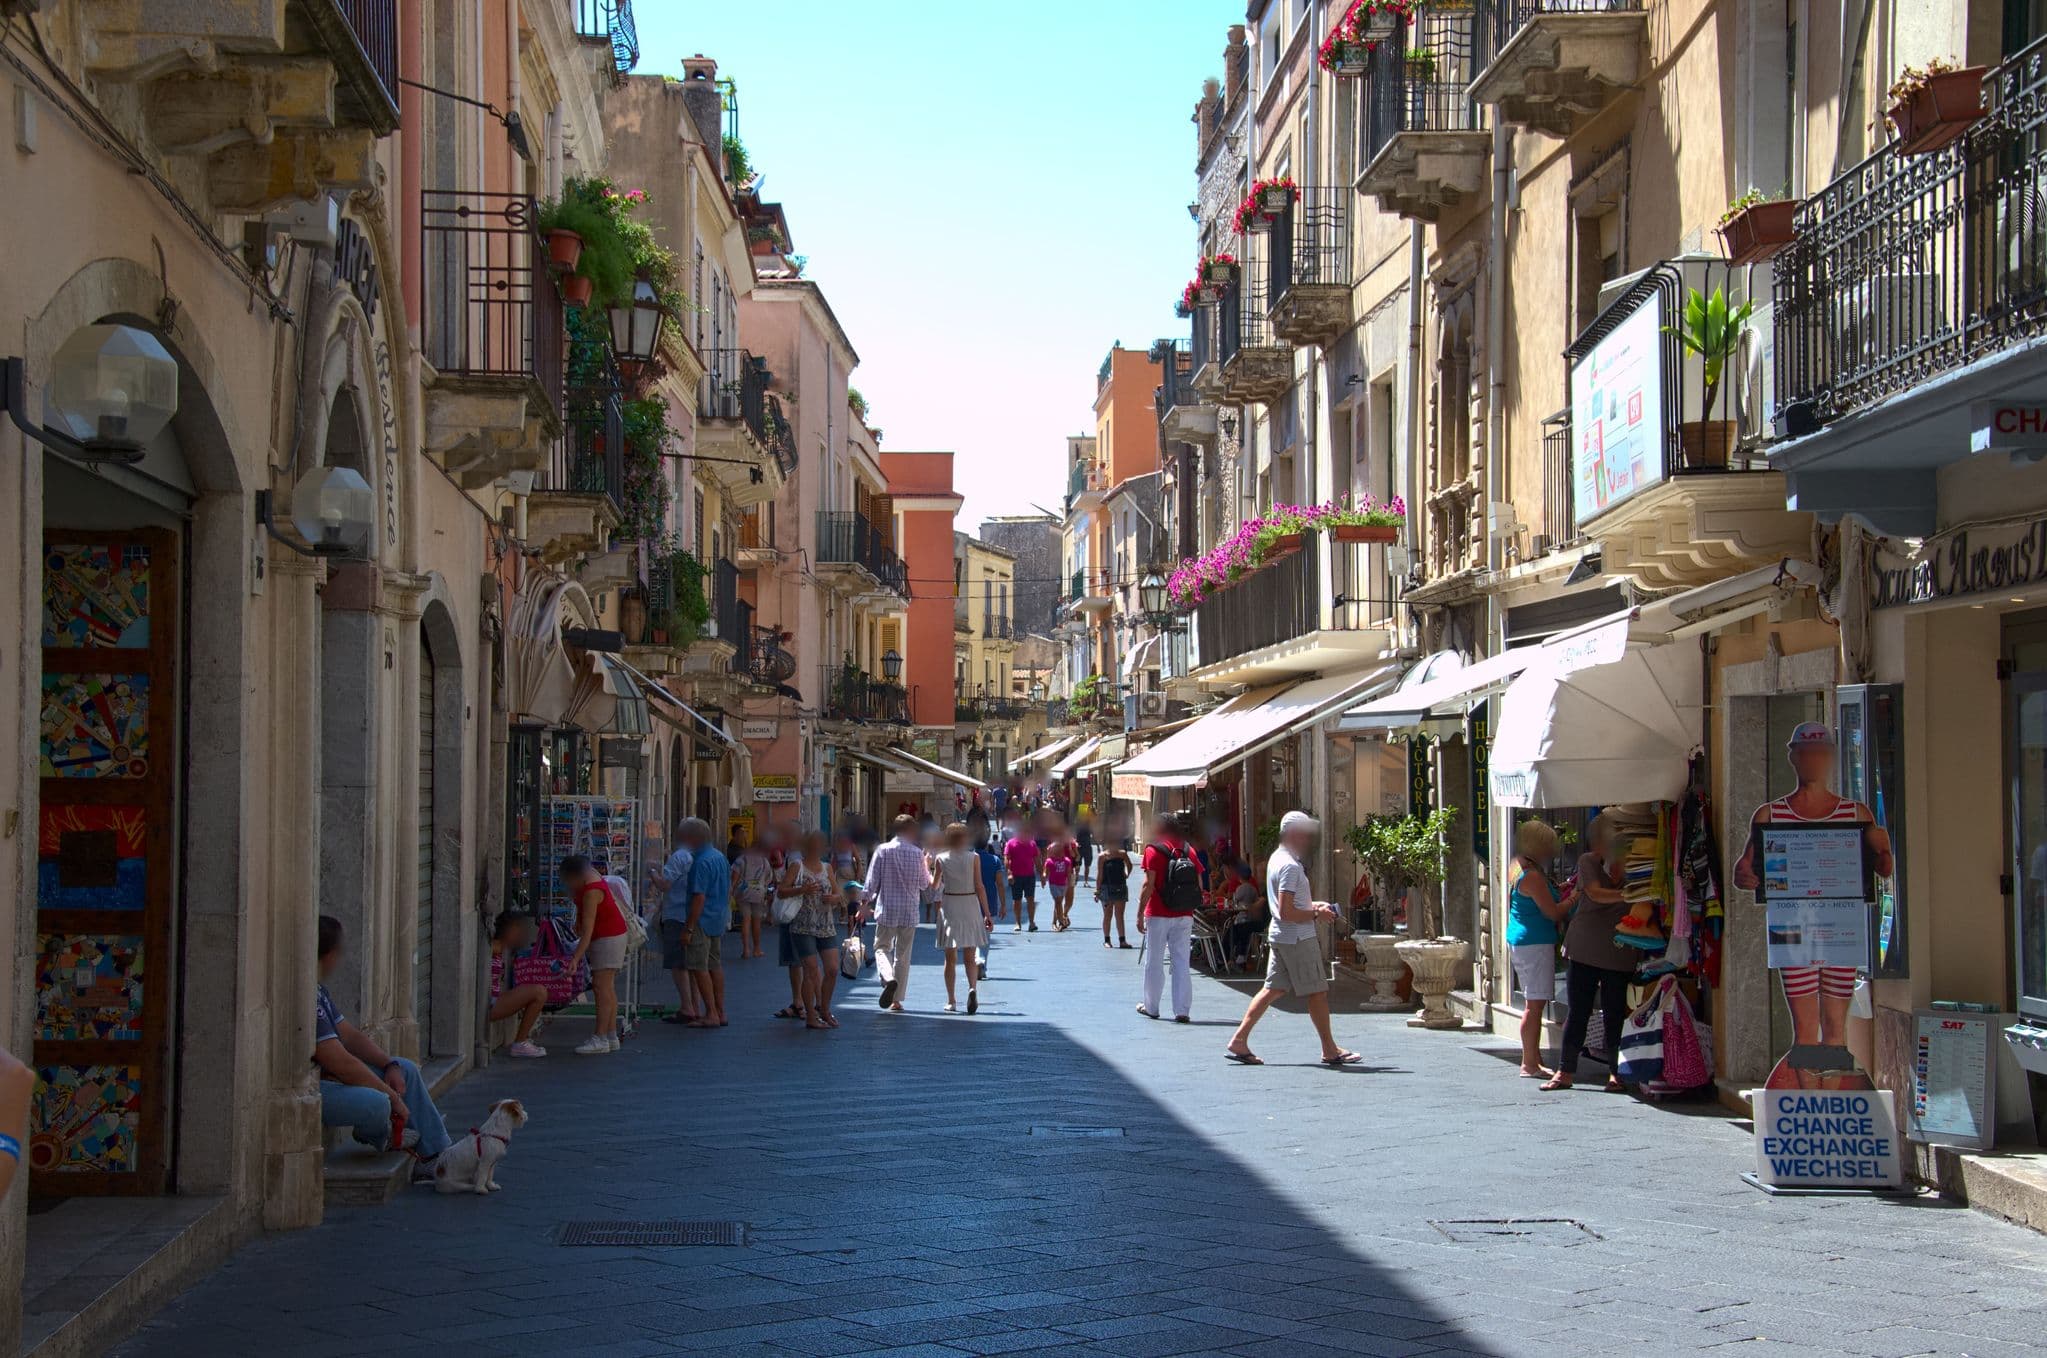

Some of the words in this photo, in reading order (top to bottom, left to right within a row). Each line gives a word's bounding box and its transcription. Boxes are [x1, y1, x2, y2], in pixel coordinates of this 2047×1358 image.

[1994, 408, 2047, 434] CH
[376, 341, 399, 547] Residence
[1800, 732, 1825, 740] SAT
[1414, 735, 1425, 818] ICTORI
[1475, 721, 1488, 833] HOTEL
[1940, 1020, 1966, 1030] SAT
[1778, 1096, 1869, 1115] CAMBIO
[1776, 1117, 1874, 1136] CHANGE
[1764, 1138, 1891, 1157] EXCHANGE
[1770, 1159, 1888, 1179] WECHSEL
